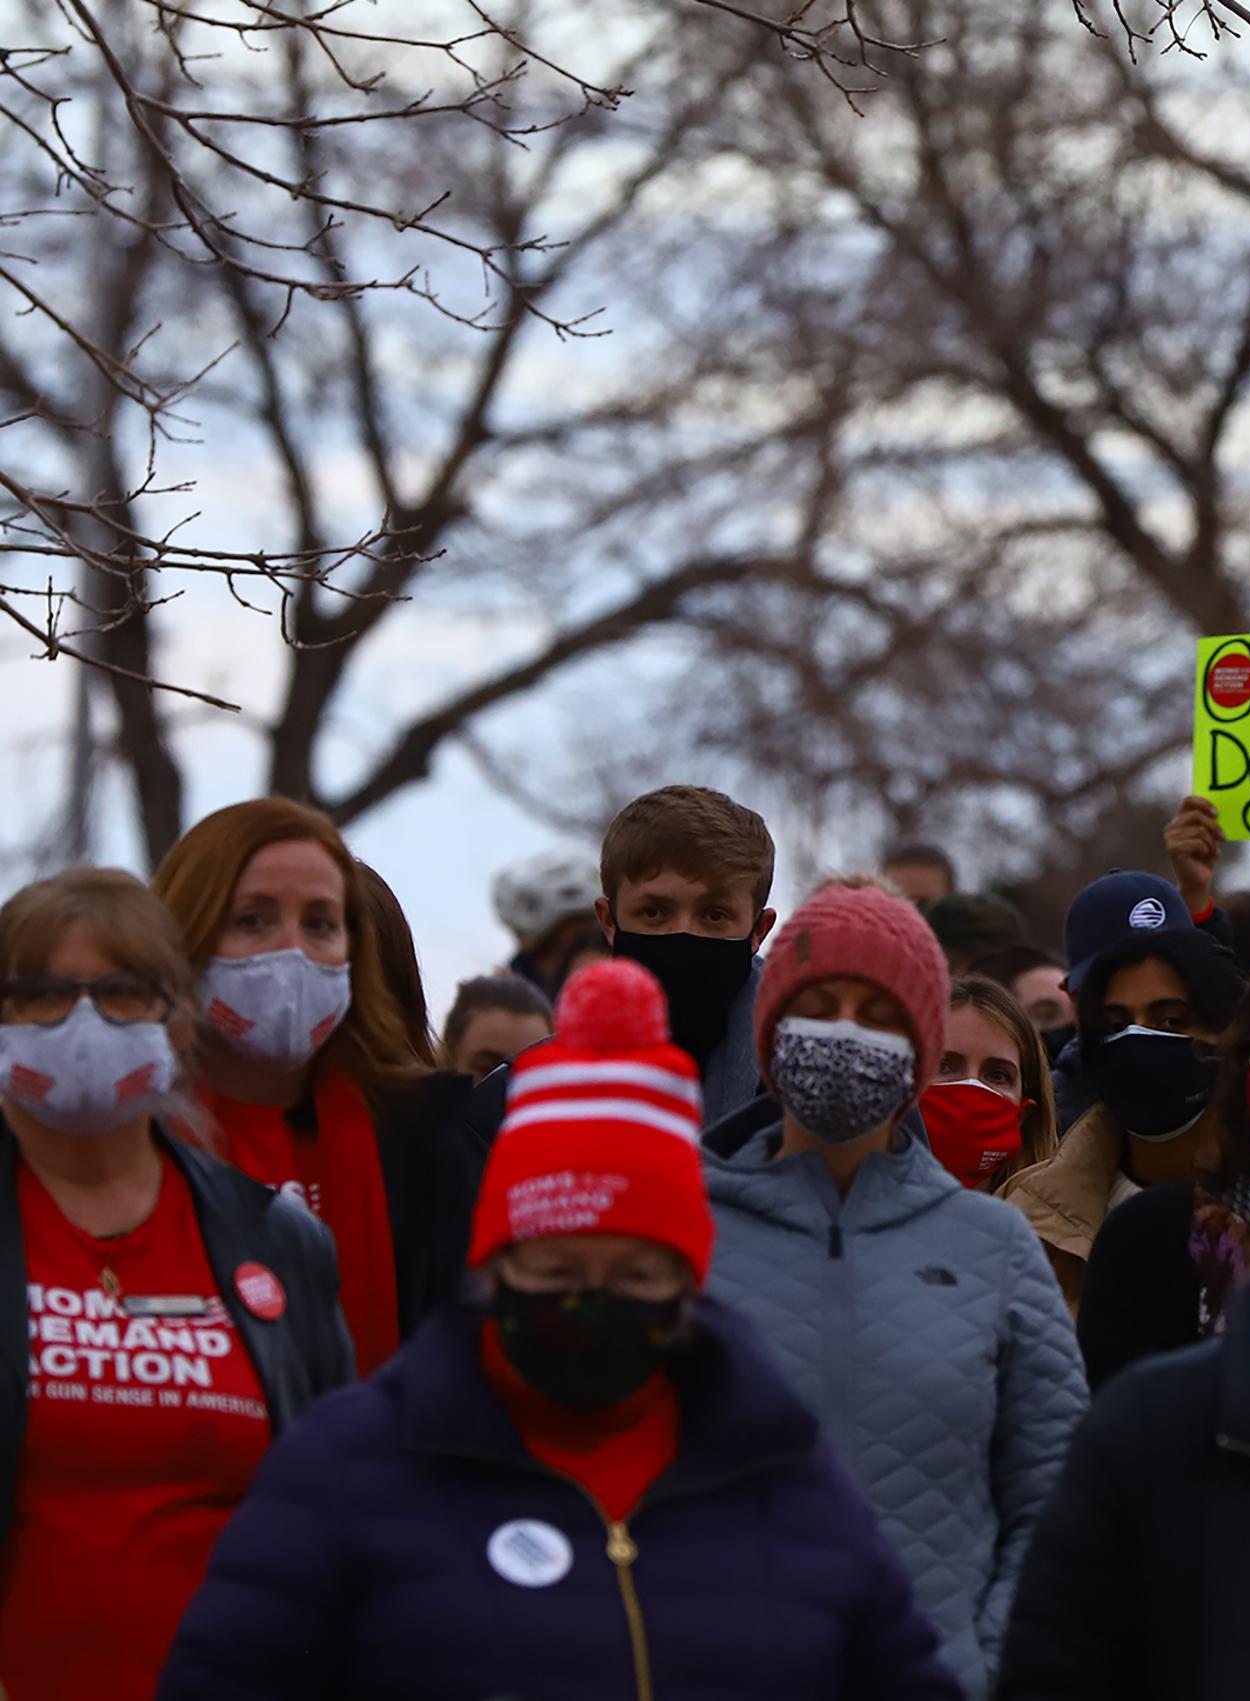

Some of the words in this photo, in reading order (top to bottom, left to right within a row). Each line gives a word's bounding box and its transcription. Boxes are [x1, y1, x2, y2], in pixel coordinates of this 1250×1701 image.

[27, 1283, 138, 1321] OM
[28, 1315, 231, 1357] EMAND
[46, 1382, 88, 1401] GUN
[91, 1385, 154, 1408] SENSE
[158, 1389, 181, 1408] IN
